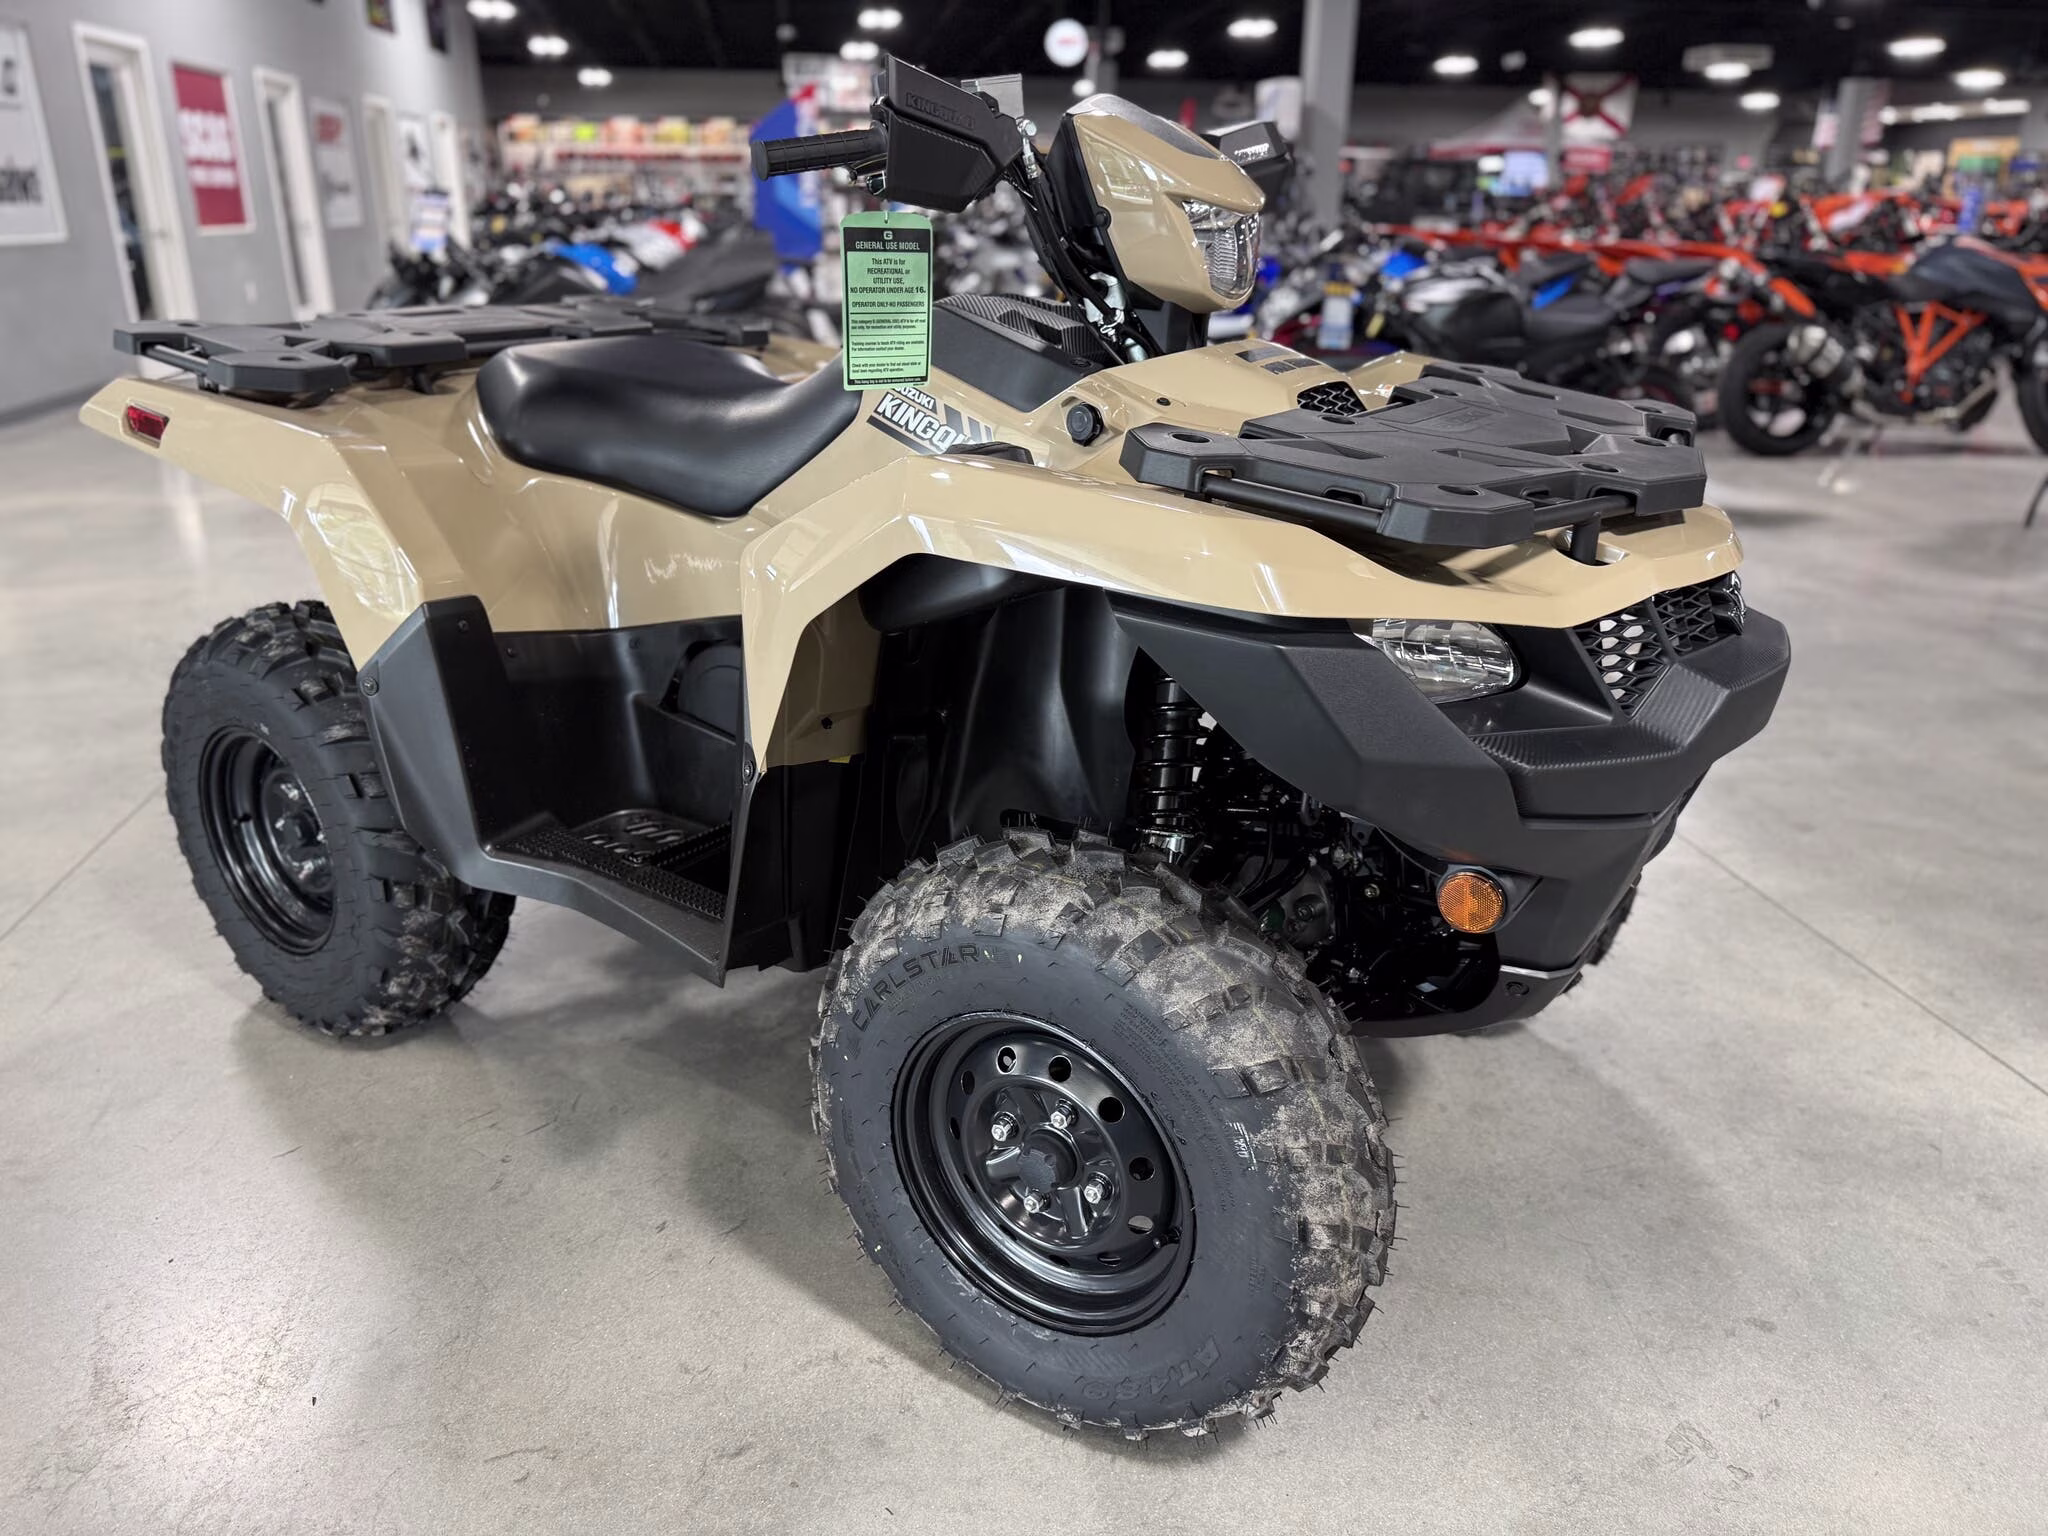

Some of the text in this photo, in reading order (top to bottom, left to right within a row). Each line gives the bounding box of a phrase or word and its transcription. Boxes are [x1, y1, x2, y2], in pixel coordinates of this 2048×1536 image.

[883, 230, 893, 240] G
[855, 240, 920, 250] GENERAL USE MODEL
[871, 257, 882, 265] This
[867, 267, 904, 275] RECREATIONAL
[872, 277, 892, 285] UTILITY
[850, 286, 858, 294] NO
[858, 286, 885, 294] OPERATOR
[886, 286, 904, 294] UNDER
[904, 286, 914, 294] AGE
[876, 393, 974, 454] KINGQ
[852, 942, 980, 1032] CARLSTAR
